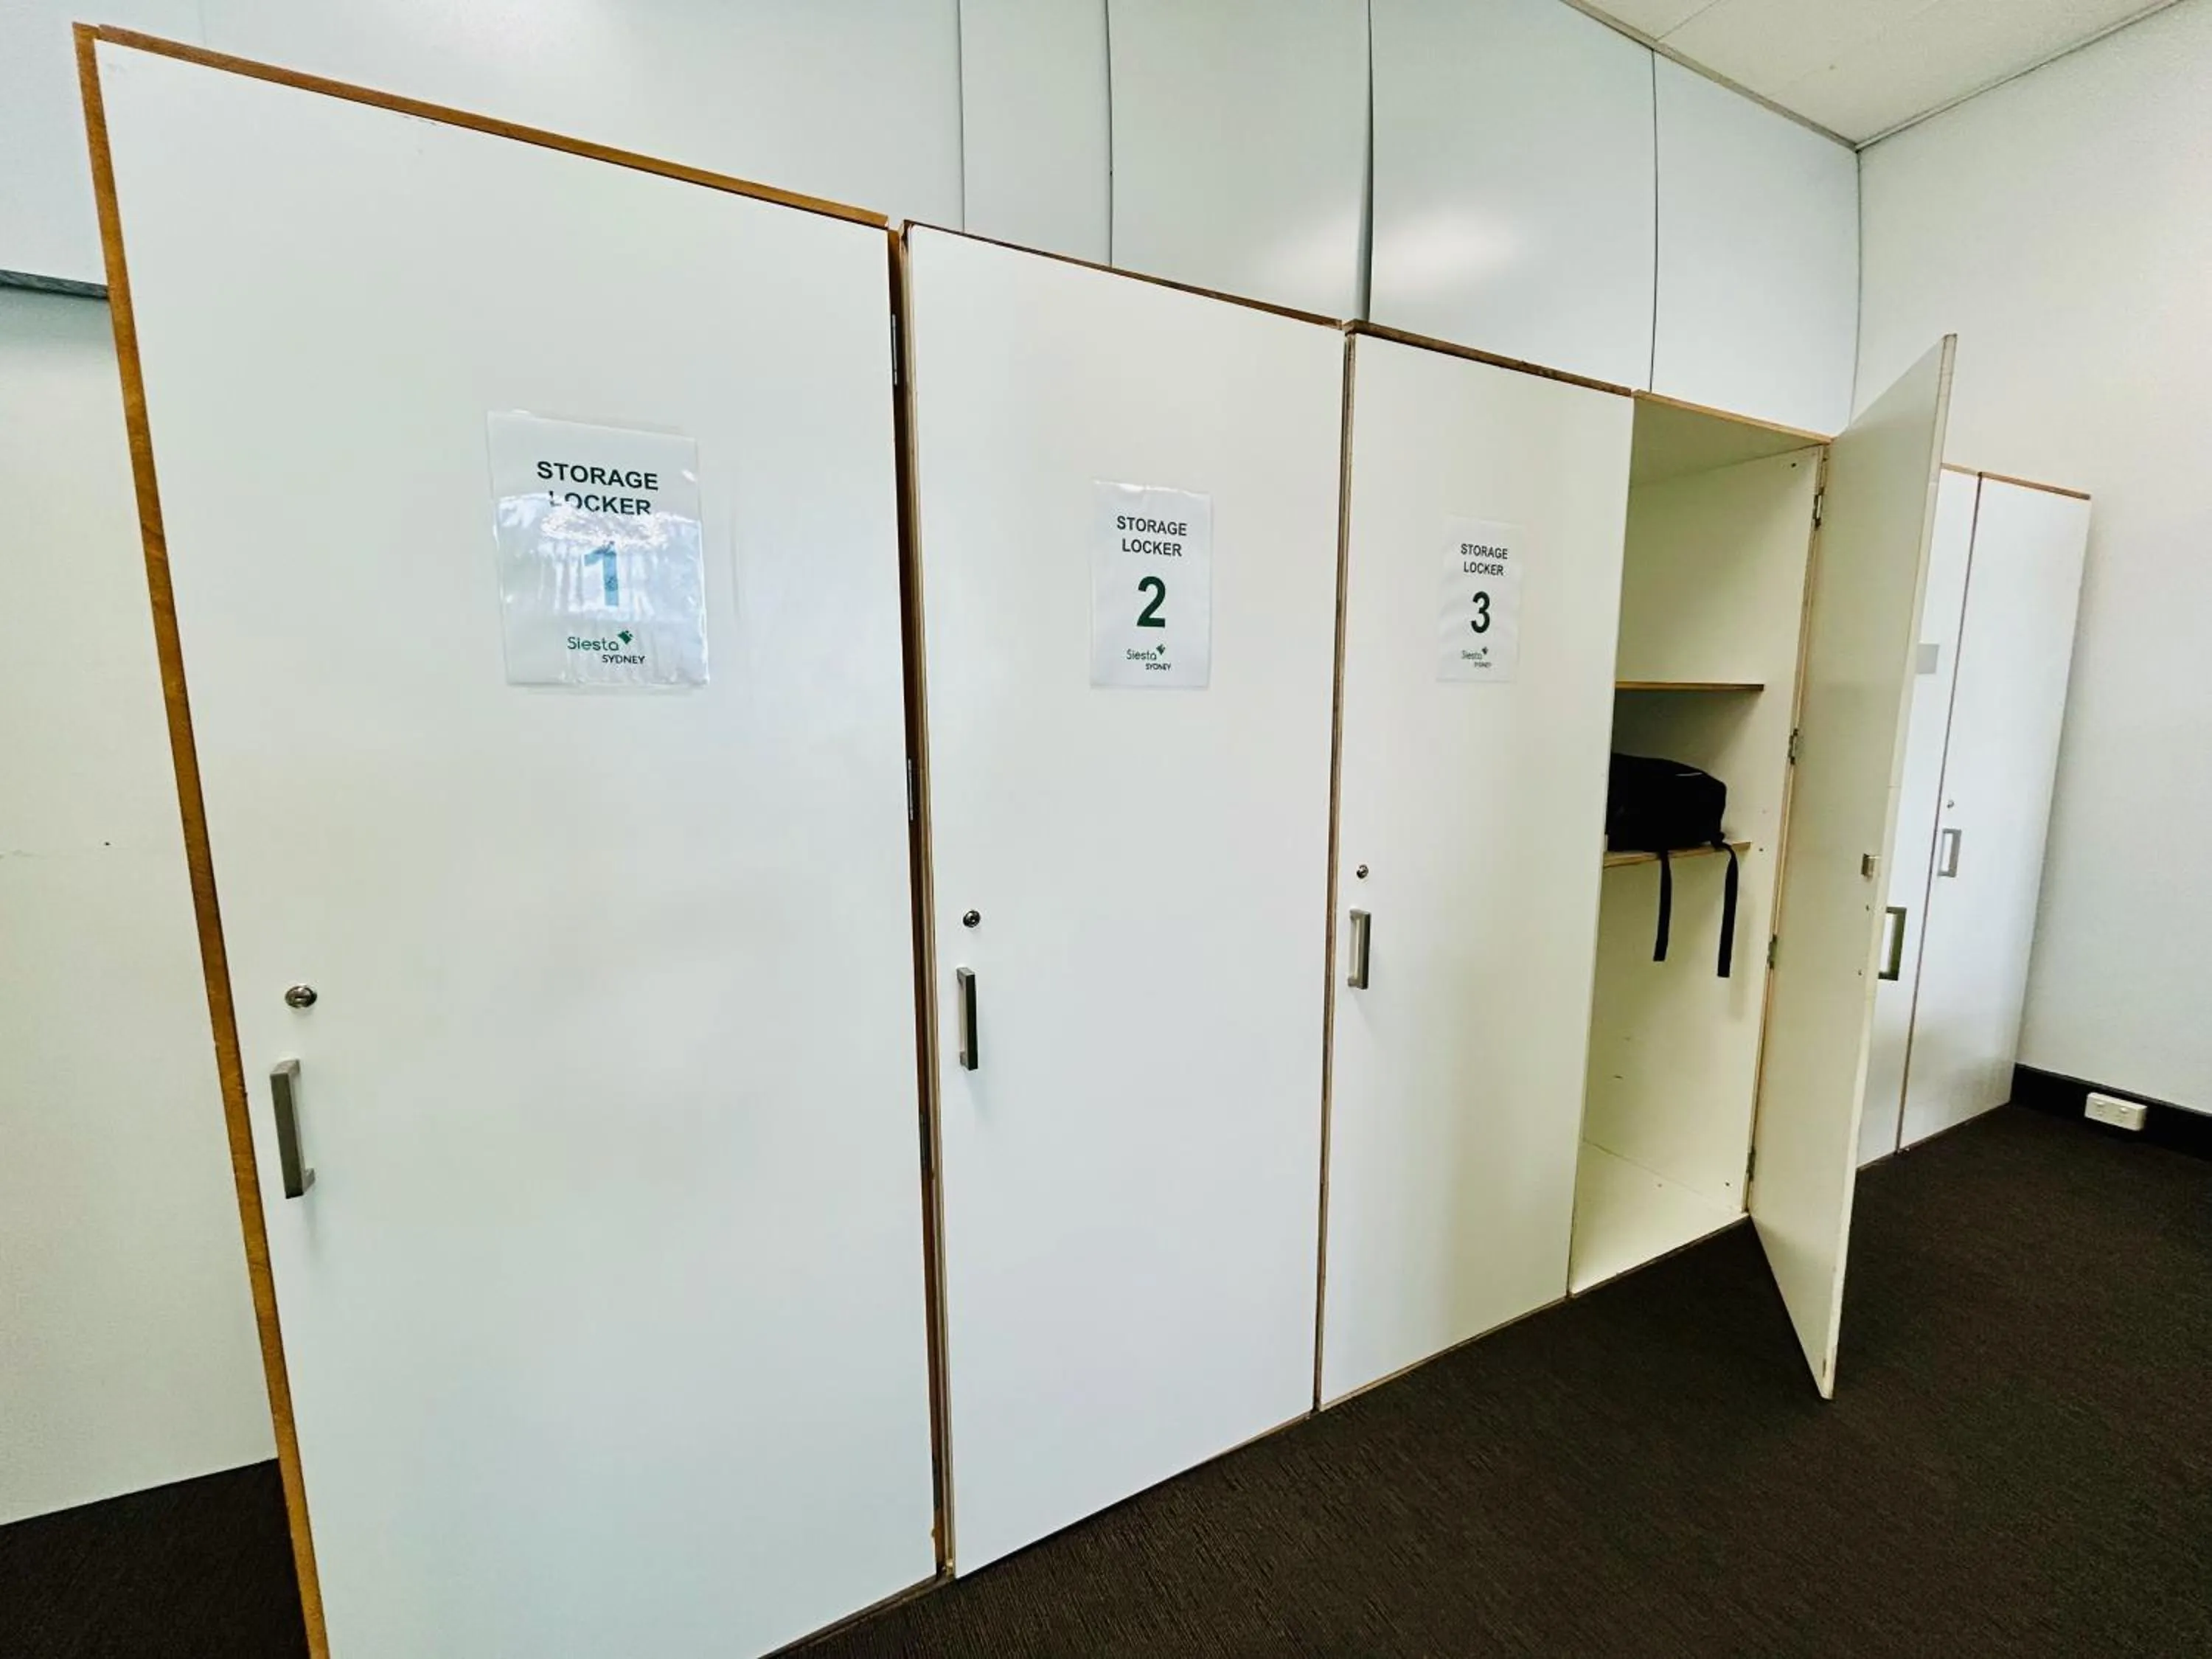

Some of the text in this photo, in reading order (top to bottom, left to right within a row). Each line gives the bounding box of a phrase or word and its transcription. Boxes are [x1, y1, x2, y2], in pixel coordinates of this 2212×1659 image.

[537, 462, 658, 490] STORAGE
[549, 490, 651, 515] LOCKER
[1117, 515, 1187, 536] STORAGE
[1122, 538, 1182, 557] LOCKER
[1461, 543, 1508, 560] STORAGE
[584, 540, 619, 607] 1
[1464, 561, 1503, 576] LOCKER
[1137, 576, 1166, 628] 2
[1471, 591, 1490, 633] 3
[567, 636, 619, 651] Siesta
[602, 654, 645, 664] SYDNEY
[1127, 649, 1157, 661] Siesta
